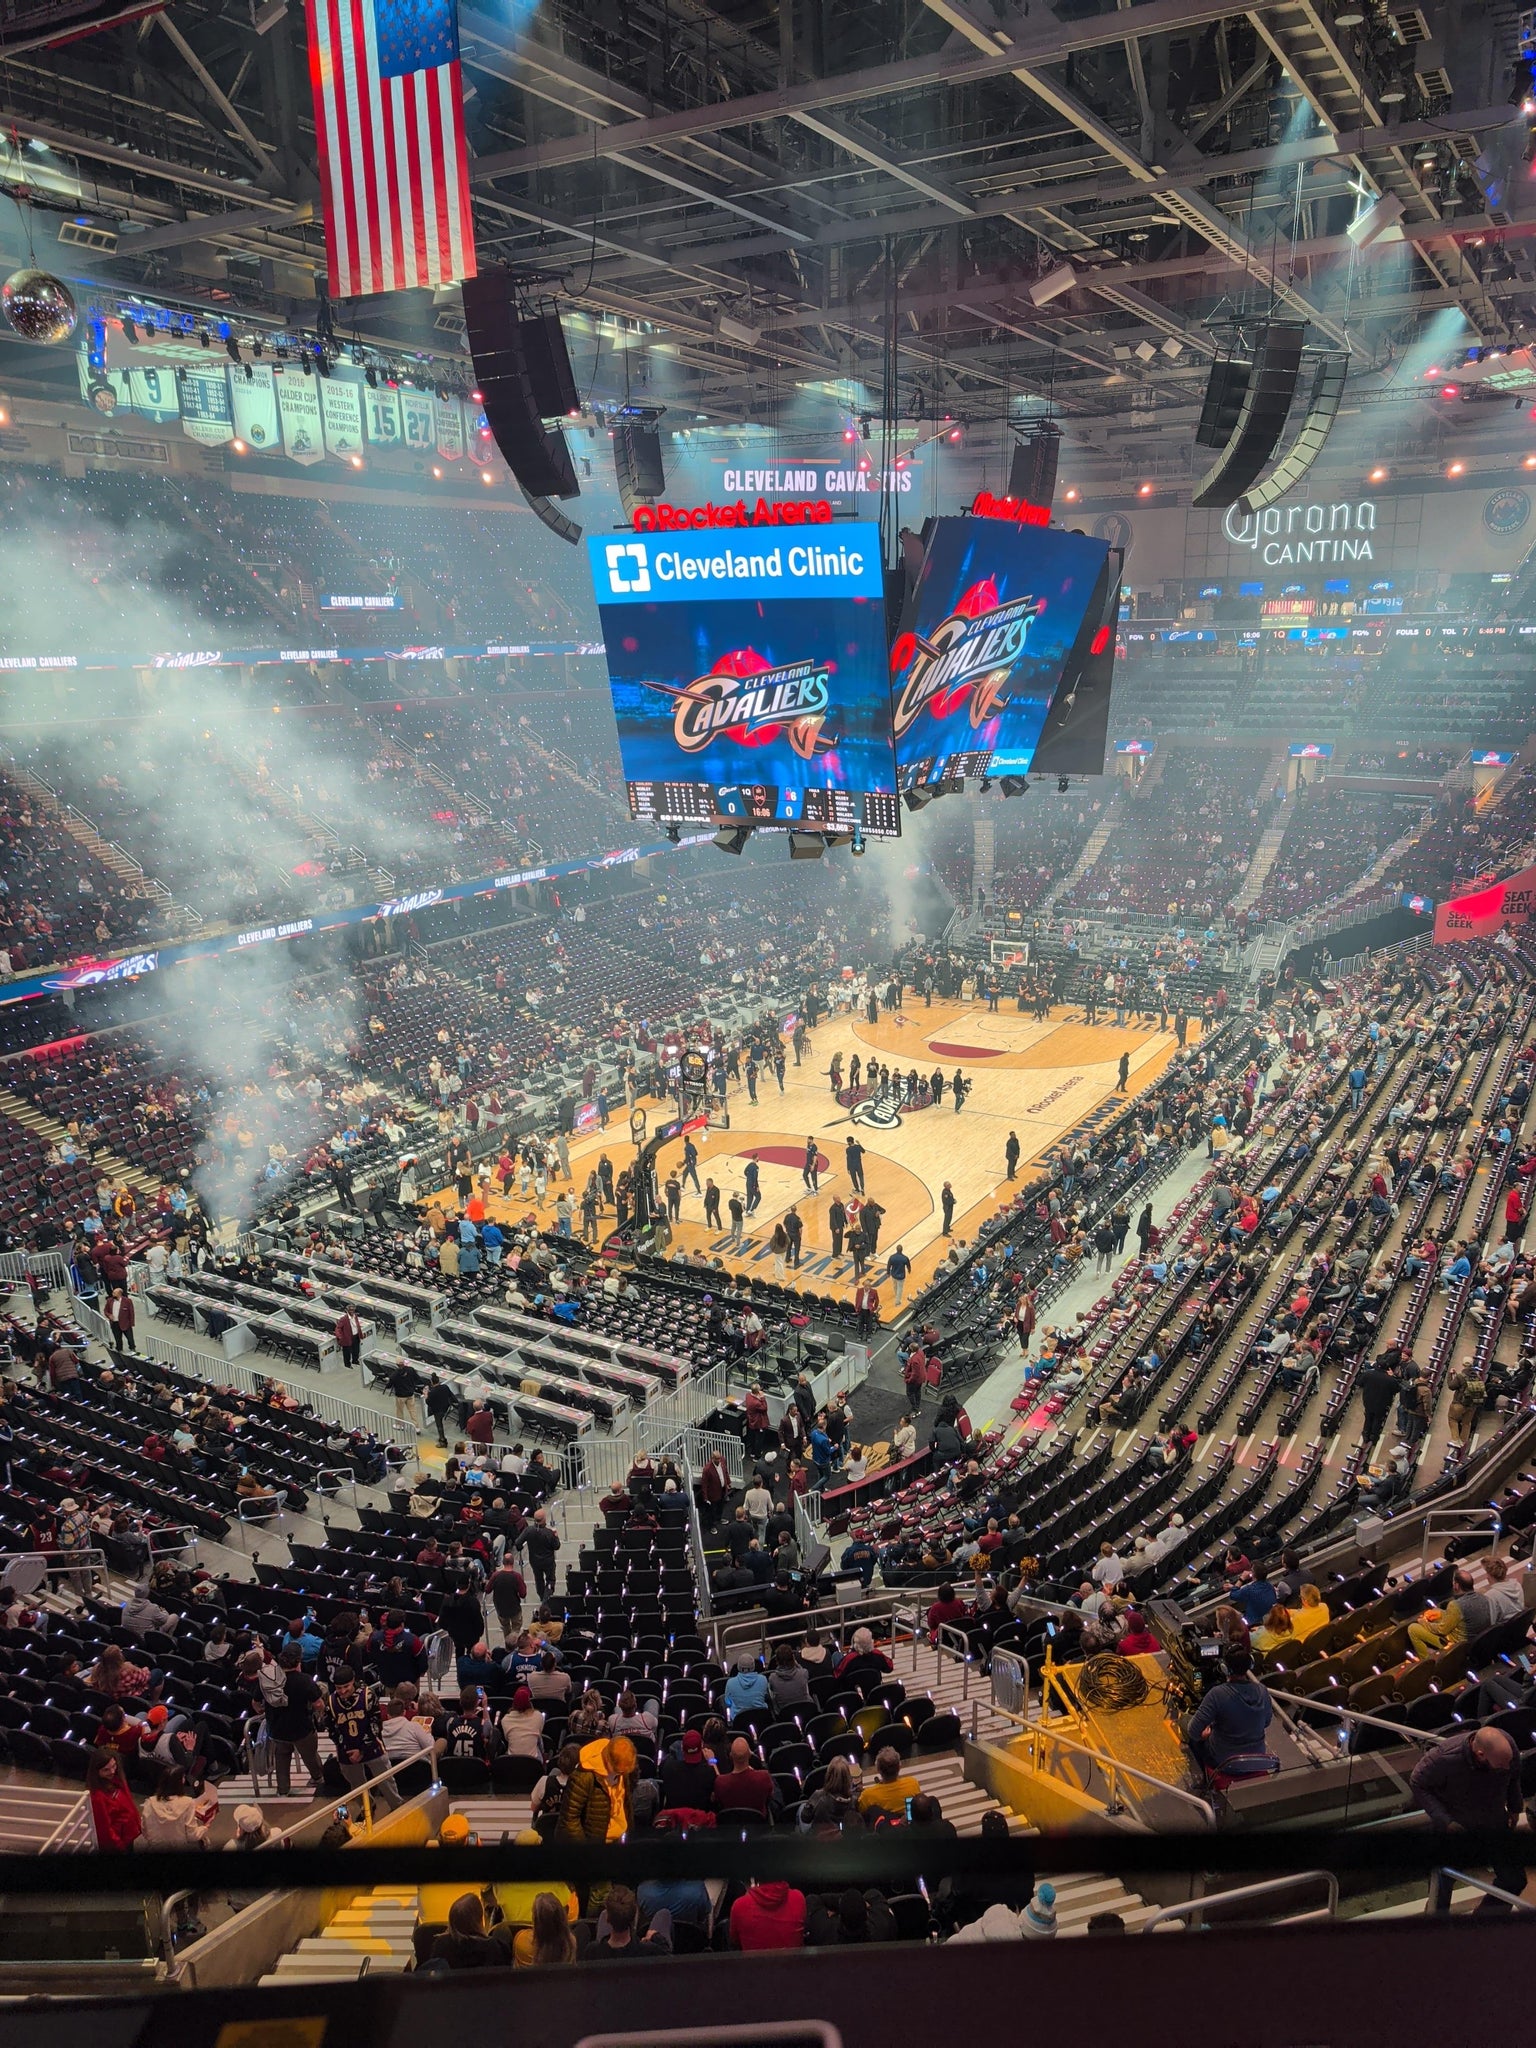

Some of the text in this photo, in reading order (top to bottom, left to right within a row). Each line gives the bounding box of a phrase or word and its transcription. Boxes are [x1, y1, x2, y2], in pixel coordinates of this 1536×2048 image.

[148, 369, 162, 404] 9
[233, 375, 272, 388] CHAMPIONS
[288, 376, 305, 388] 2016
[280, 389, 317, 404] CALDER CUP
[326, 385, 353, 398] 2015-16
[282, 401, 318, 416] CHAMPIONS
[328, 399, 355, 411] WESTERN
[326, 410, 360, 423] CONFERENCE
[373, 404, 396, 436] 15
[328, 422, 359, 434] CHAMPIONS
[408, 412, 430, 442] 27
[724, 470, 817, 493] CLEVELAND
[656, 496, 833, 531] Rocket Arena
[1222, 500, 1377, 549] Corona
[1263, 539, 1374, 566] CANTINA
[655, 546, 864, 581] Cleveland Clinic
[331, 595, 395, 607] CLEVELAND CAVALIERS
[967, 603, 1025, 636] CLEVELAND
[1273, 631, 1286, 639] 1Q
[1376, 629, 1382, 637] 0
[39, 656, 78, 667] CAVALIERS
[280, 650, 338, 660] CLEVELAND CAVALIERS
[744, 665, 811, 690] CLEVELAND
[894, 616, 1035, 732] CAVALIERS
[674, 674, 829, 747] CAVALIERS
[728, 802, 736, 814] 0
[752, 807, 771, 817] 16:06
[786, 806, 793, 817] 0
[495, 868, 546, 888] CLEVELAND CAVALIERS
[1504, 890, 1533, 902] SEAT
[1448, 910, 1472, 920] SEAT
[1501, 902, 1532, 914] GEEK
[1446, 920, 1473, 929] GEEK
[238, 919, 313, 945] CLEVELAND CAVALIERS
[1036, 1076, 1084, 1112] Rocket Arena
[1078, 1096, 1130, 1134] KNOW.
[40, 1532, 53, 1544] 23
[348, 1720, 359, 1737] 0
[452, 1725, 478, 1738] MITCHELL
[453, 1740, 474, 1757] 45
